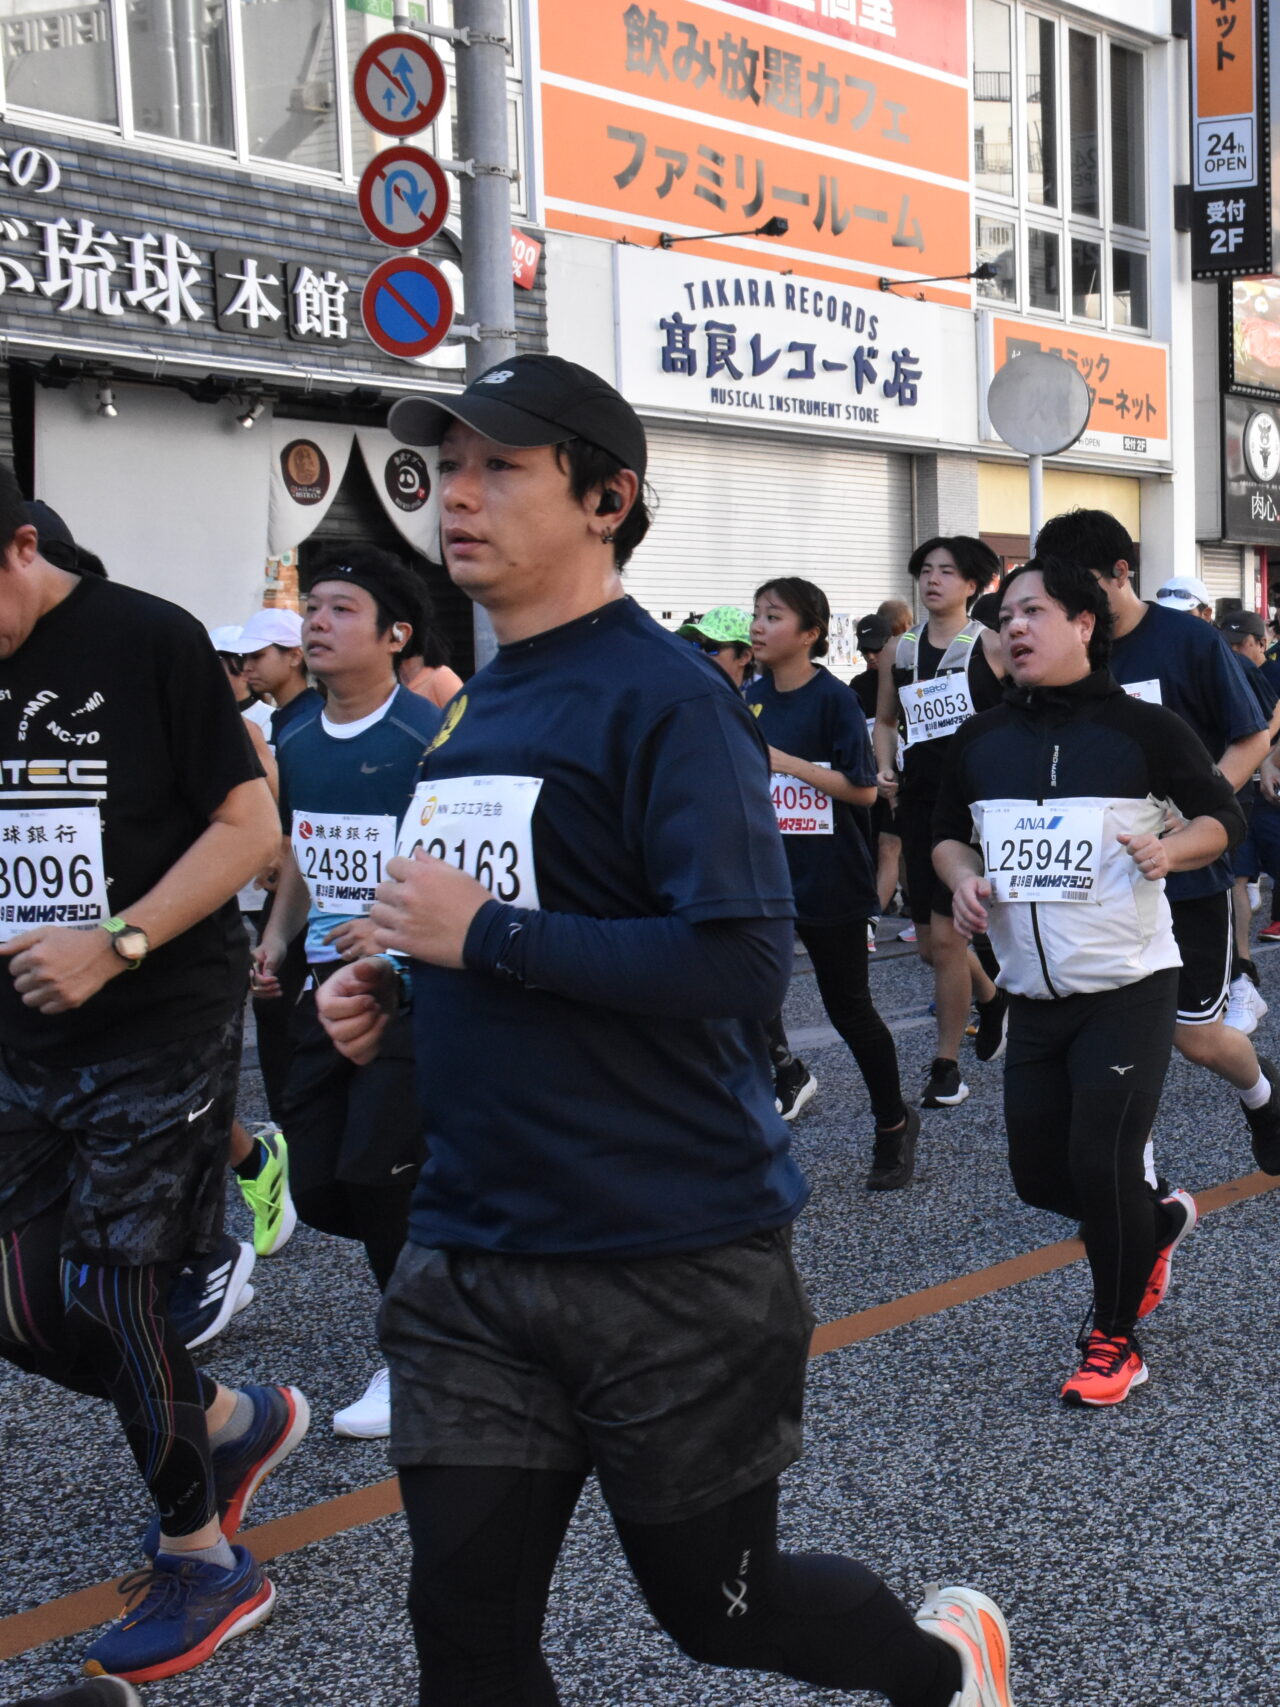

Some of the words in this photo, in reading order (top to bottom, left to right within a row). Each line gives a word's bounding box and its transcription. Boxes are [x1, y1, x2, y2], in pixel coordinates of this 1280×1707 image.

[623, 4, 911, 144] 飲み放題カフェ
[0, 147, 61, 193] の
[1204, 156, 1247, 173] OPEN
[607, 125, 925, 254] ファミリールーム
[1207, 199, 1246, 224] 受付
[1209, 228, 1245, 255] 2F
[222, 258, 350, 340] 本館
[684, 278, 776, 311] TAKARA
[785, 283, 879, 341] RECORDS
[711, 387, 765, 410] MUSICAL
[769, 395, 841, 419] INSTRUMENT
[845, 405, 880, 424] STORE
[905, 693, 968, 725] L26053
[46, 720, 101, 746] NC-70
[0, 759, 108, 785] TEC
[3, 824, 77, 844] 球銀行
[315, 824, 380, 842] 琉球銀行
[1014, 817, 1046, 831] ANA
[986, 838, 1093, 873] L25942
